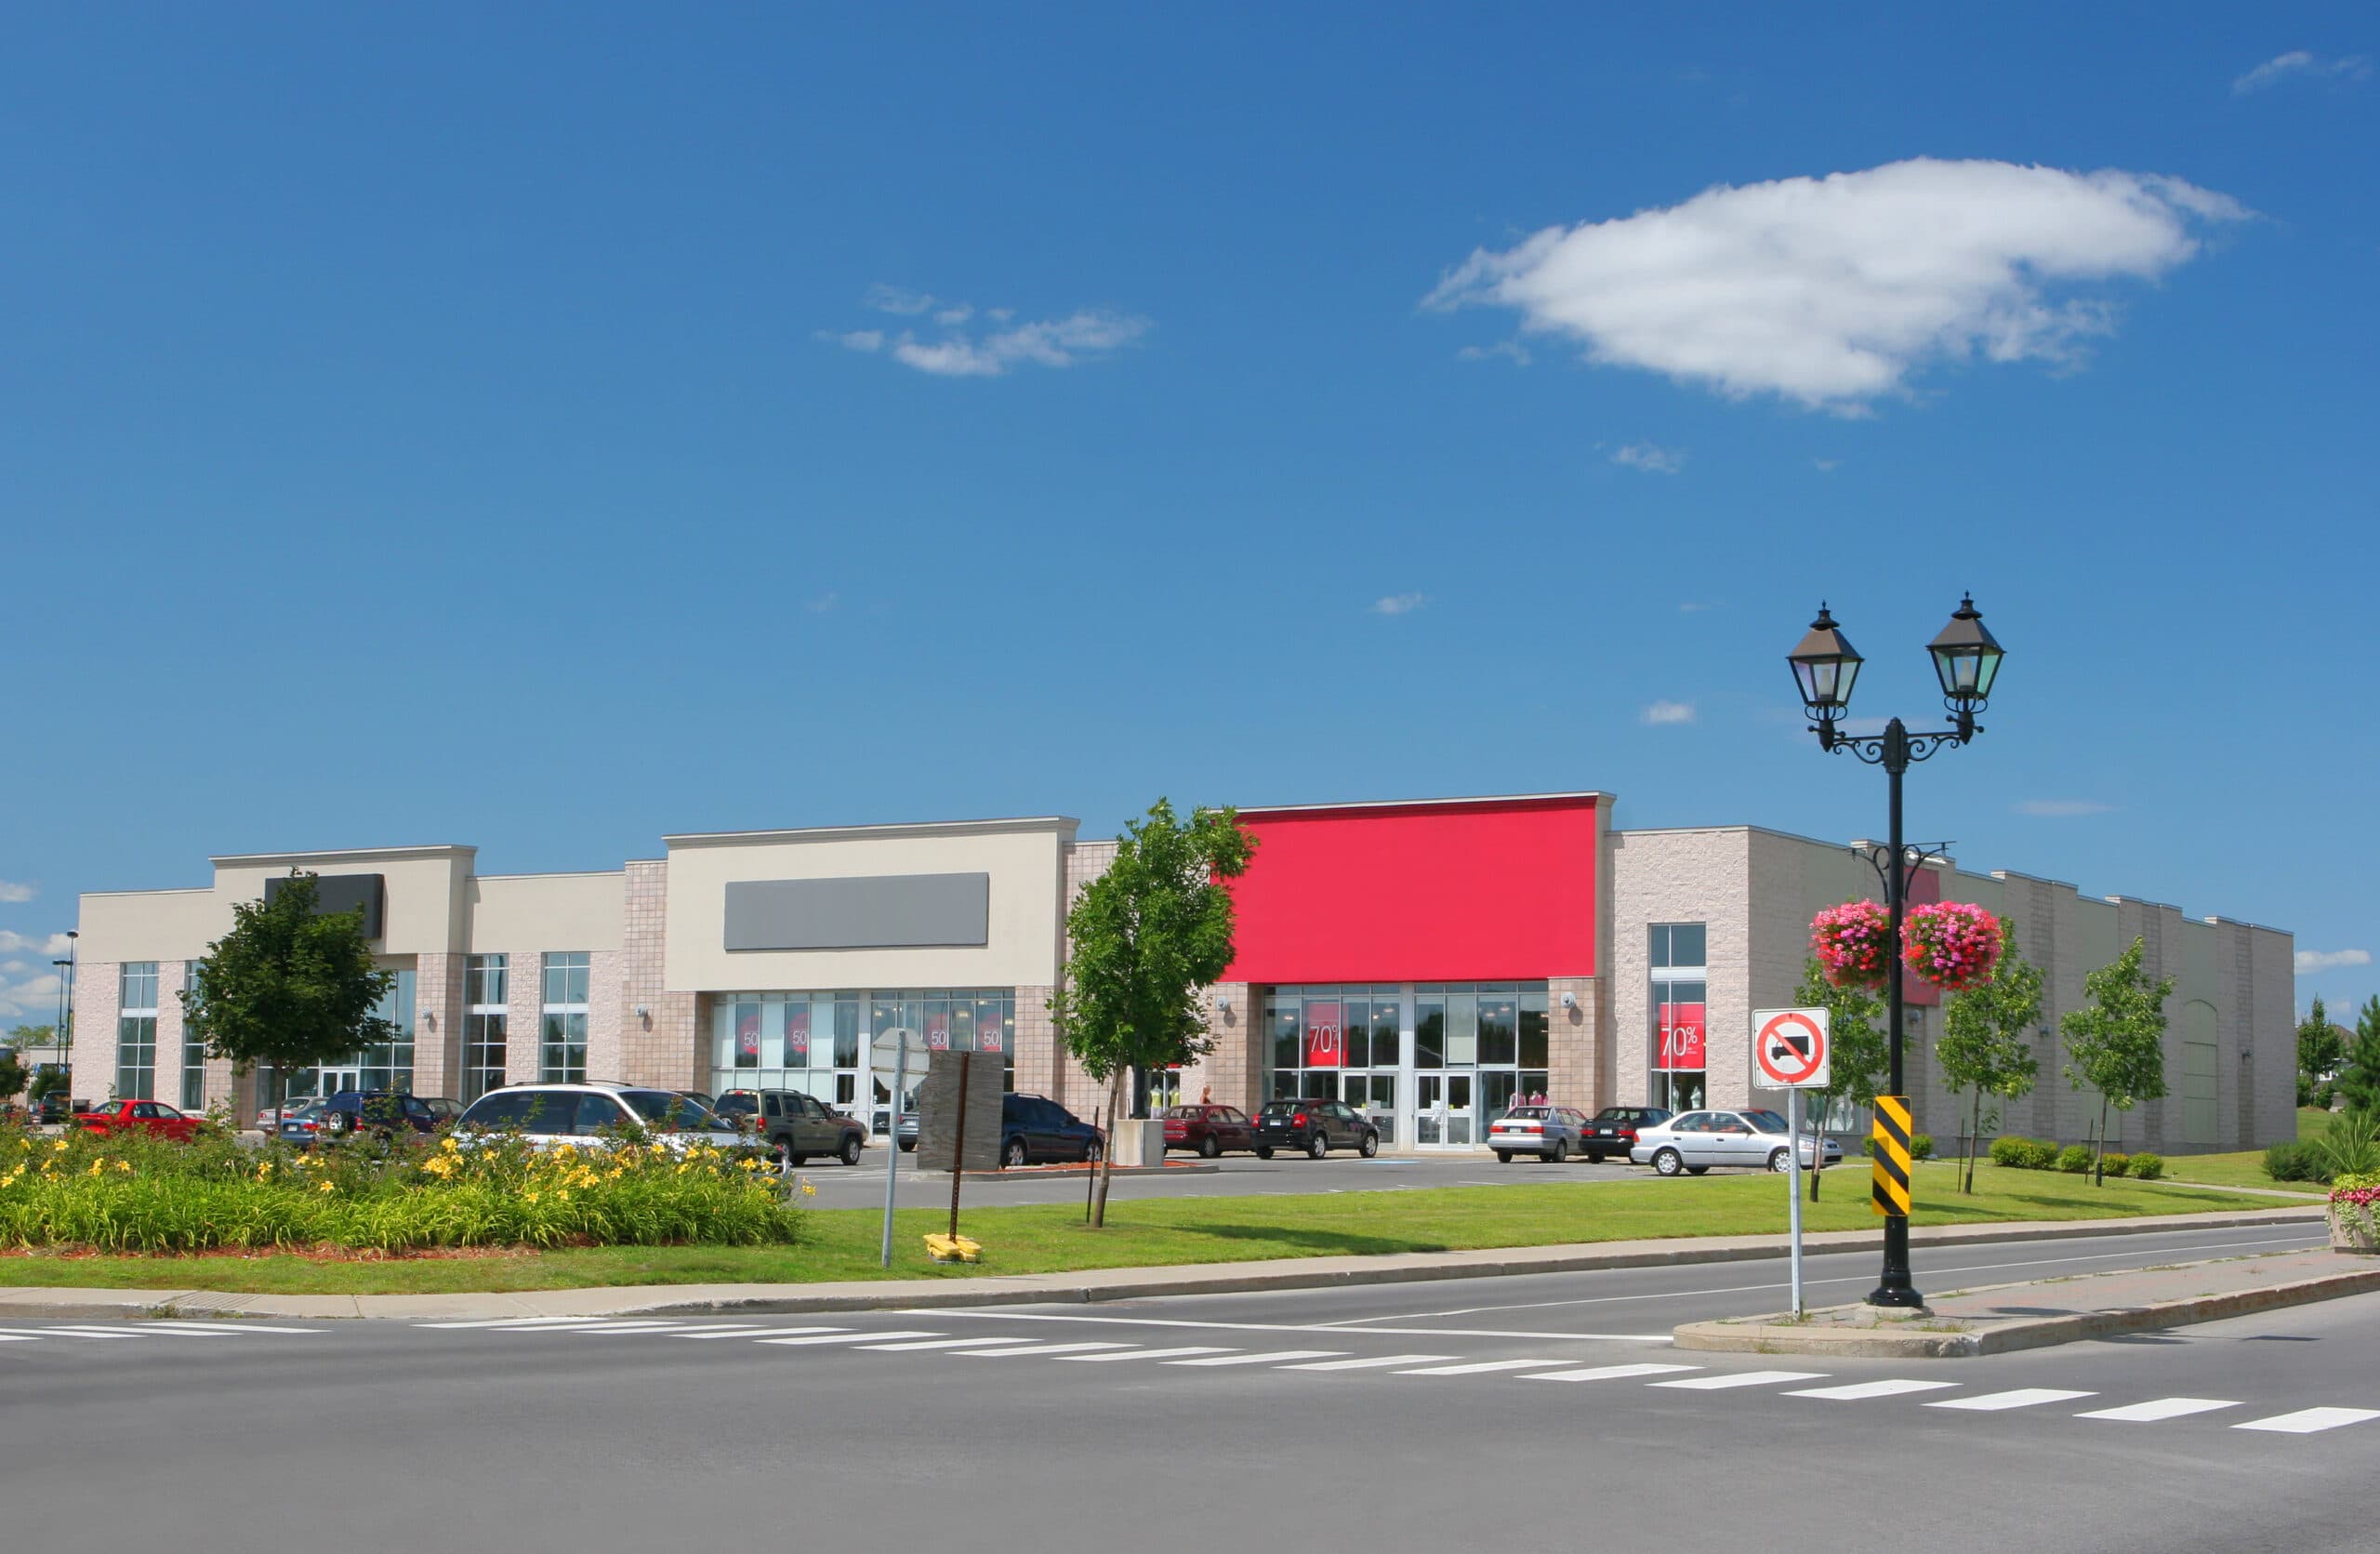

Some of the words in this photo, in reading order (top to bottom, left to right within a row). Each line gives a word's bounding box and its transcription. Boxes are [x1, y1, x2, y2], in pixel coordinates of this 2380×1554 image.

[744, 1032, 758, 1046] 50
[793, 1030, 807, 1044] 50
[932, 1030, 946, 1045] 50
[984, 1030, 999, 1045] 50
[1661, 1026, 1699, 1056] 70%
